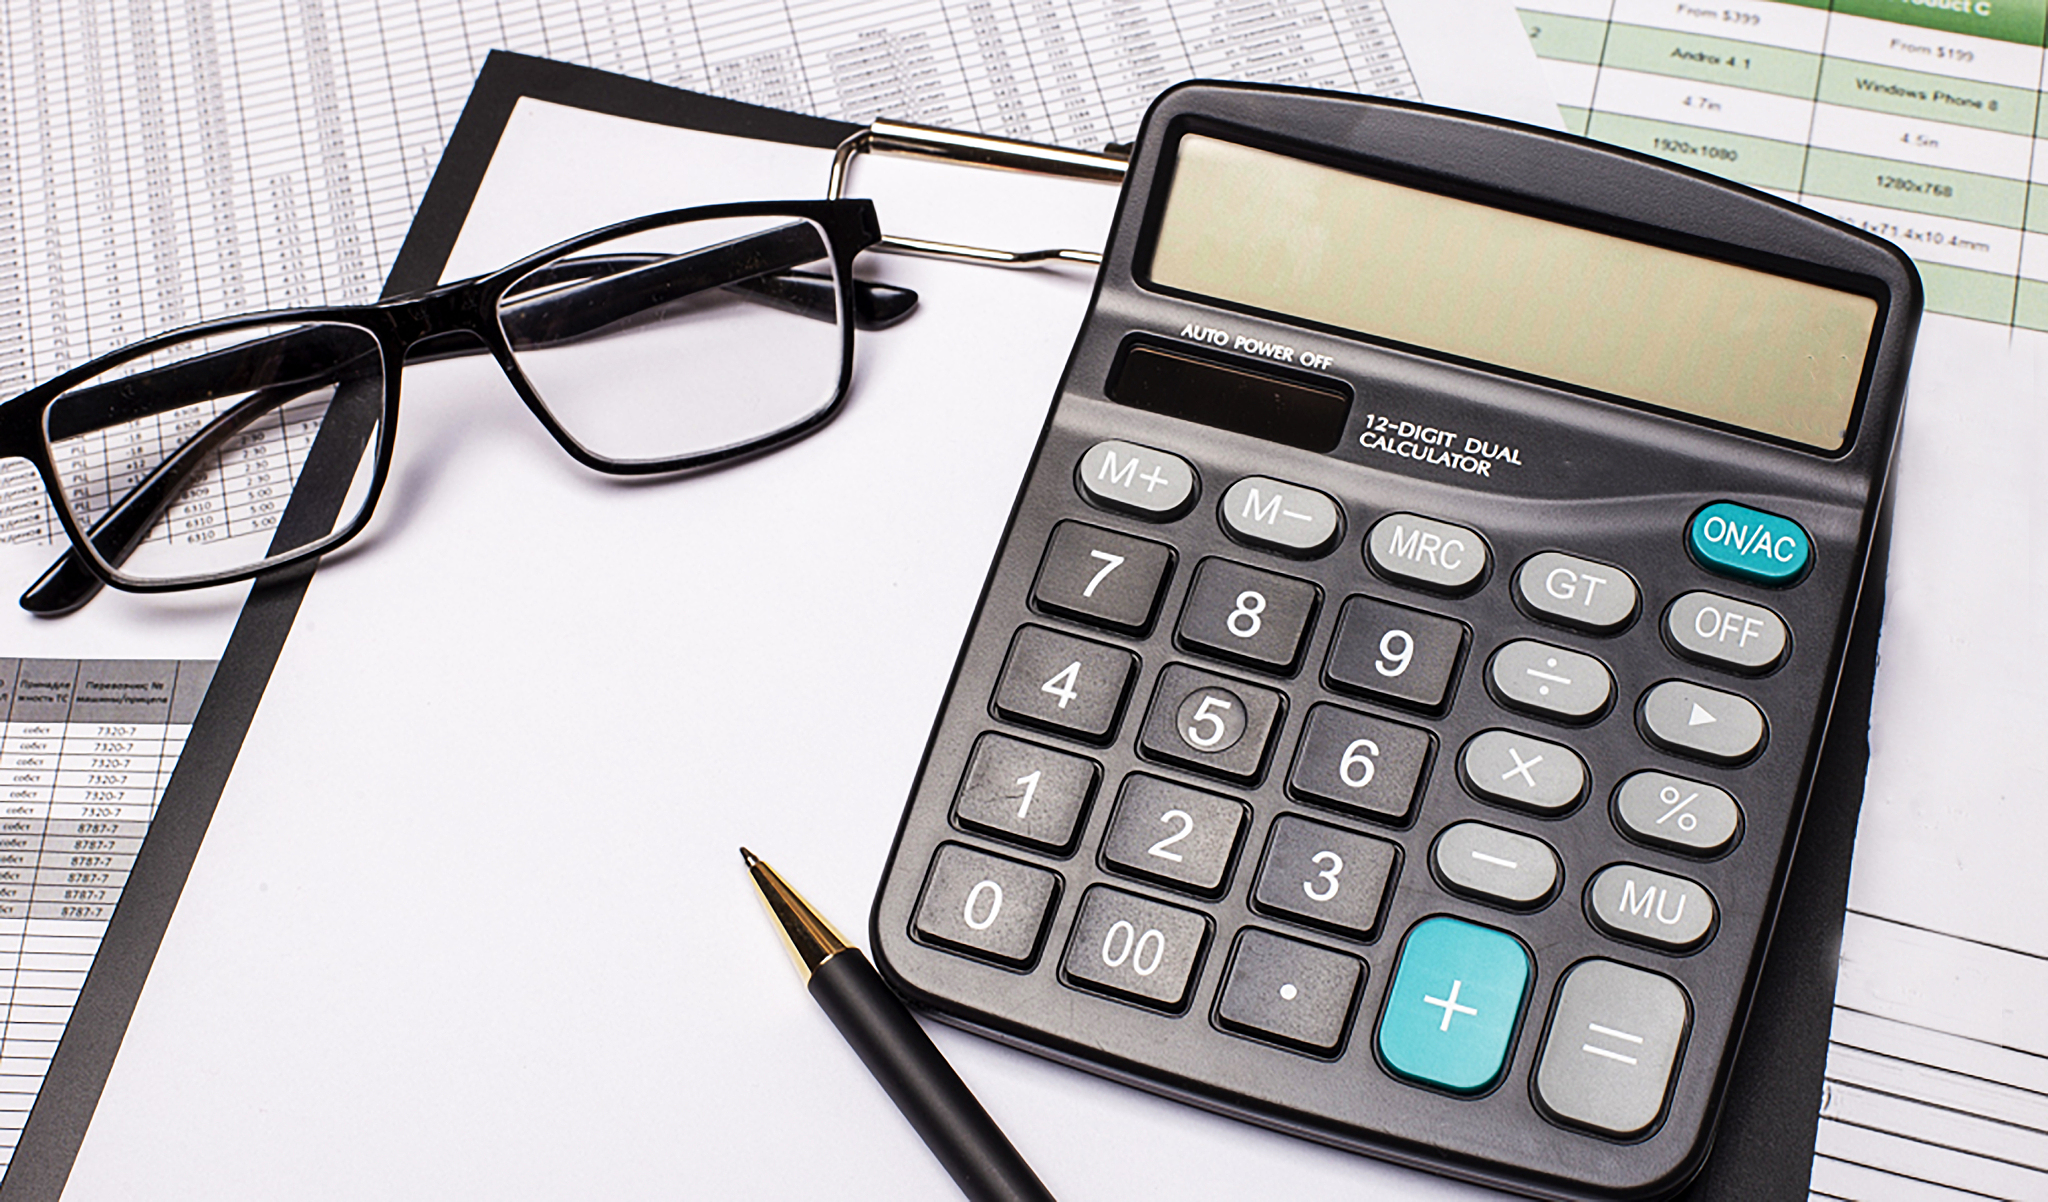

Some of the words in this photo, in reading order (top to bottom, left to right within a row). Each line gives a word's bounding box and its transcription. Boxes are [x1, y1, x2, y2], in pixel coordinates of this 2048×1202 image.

[1676, 3, 1717, 18] From
[1722, 10, 1761, 26] $399
[1973, 1, 1991, 17] C
[1889, 38, 1931, 55] From
[1936, 46, 1975, 63] $199
[1855, 77, 1927, 101] Windows
[1932, 90, 1983, 110] Phone
[1986, 99, 1999, 112] 8
[1653, 137, 1738, 162] 1920x1080
[1875, 174, 1954, 199] 1280x768
[1181, 323, 1229, 347] AUTO
[1234, 335, 1294, 362] POWER
[1300, 351, 1333, 371] OFF
[1359, 430, 1491, 477] CALCULATOR
[1365, 414, 1457, 448] 12-DIGIT
[1464, 437, 1522, 466] DUAL
[1097, 451, 1169, 493] M+
[1388, 525, 1465, 571] MRC
[1703, 516, 1796, 563] ON/AC
[1082, 549, 1124, 598] 7
[1545, 568, 1607, 606] GT
[1226, 590, 1267, 638] 8
[1694, 606, 1764, 648] OFF
[1374, 629, 1415, 677] 9
[1041, 661, 1081, 709] 4
[1187, 695, 1232, 746] 5
[1338, 739, 1380, 787] 6
[1015, 770, 1042, 818] 1
[1655, 785, 1699, 831] %
[73, 839, 116, 851] 8787-7
[77, 823, 119, 834] 8787-7
[1147, 809, 1194, 863] 2
[67, 872, 109, 884] 8787-7
[70, 856, 113, 867] 8787-7
[1303, 851, 1344, 902] 3
[60, 906, 103, 918] 8787-7
[64, 889, 106, 901] 8787-7
[963, 880, 1004, 930] 0
[1619, 880, 1687, 925] MU
[1101, 920, 1165, 976] 00
[1423, 980, 1478, 1032] +
[1582, 1023, 1644, 1066] =
